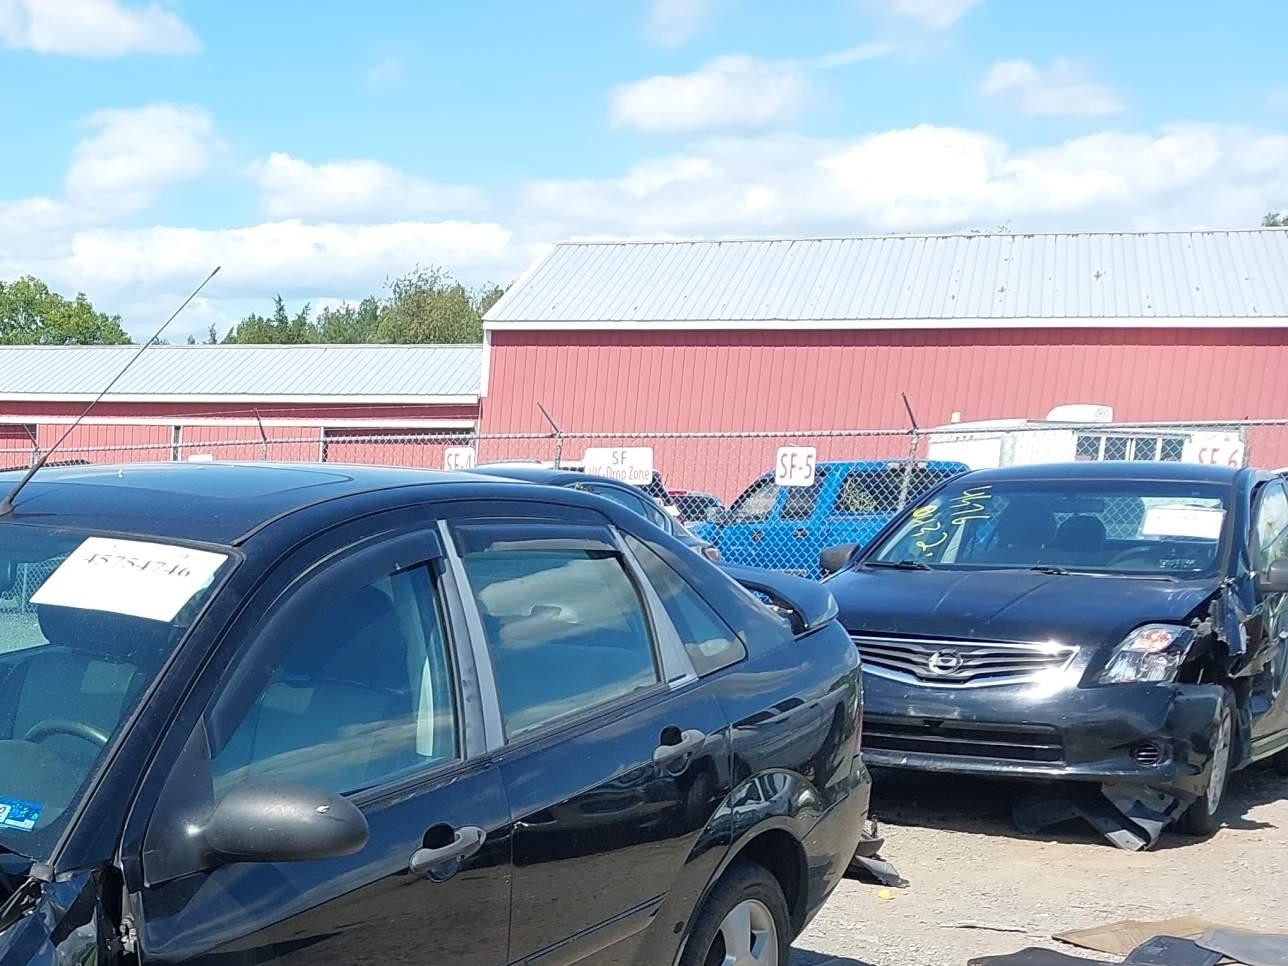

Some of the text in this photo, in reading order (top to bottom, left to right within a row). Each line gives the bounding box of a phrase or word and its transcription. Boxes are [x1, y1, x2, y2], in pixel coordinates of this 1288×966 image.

[611, 450, 629, 465] SF
[779, 453, 813, 480] SF-5
[628, 465, 650, 480] Zone
[83, 552, 191, 578] 45754746
